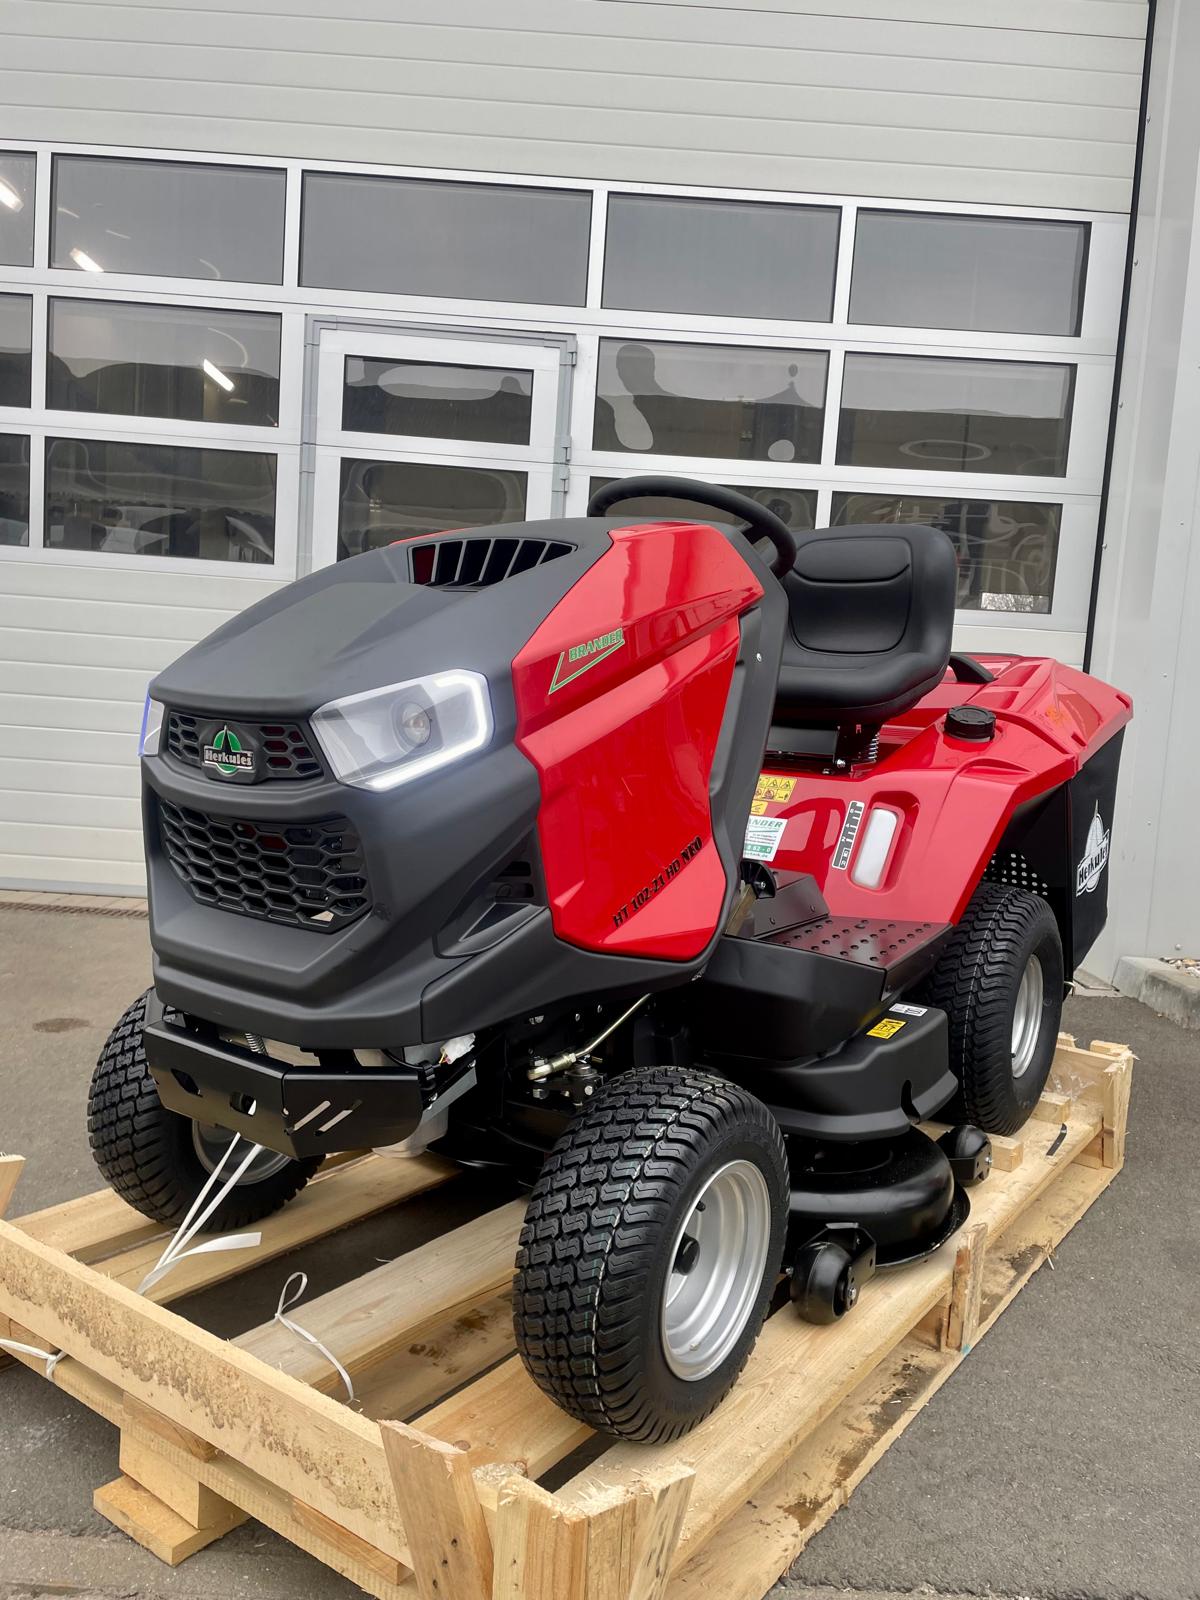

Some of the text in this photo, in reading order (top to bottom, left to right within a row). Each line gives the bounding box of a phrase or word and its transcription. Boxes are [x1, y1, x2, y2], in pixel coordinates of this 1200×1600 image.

[569, 628, 622, 661] BRANDER
[205, 750, 251, 765] Herkules
[1079, 842, 1108, 886] Herkules
[613, 904, 630, 928] HT
[631, 873, 666, 912] 102-21
[664, 858, 680, 880] HD
